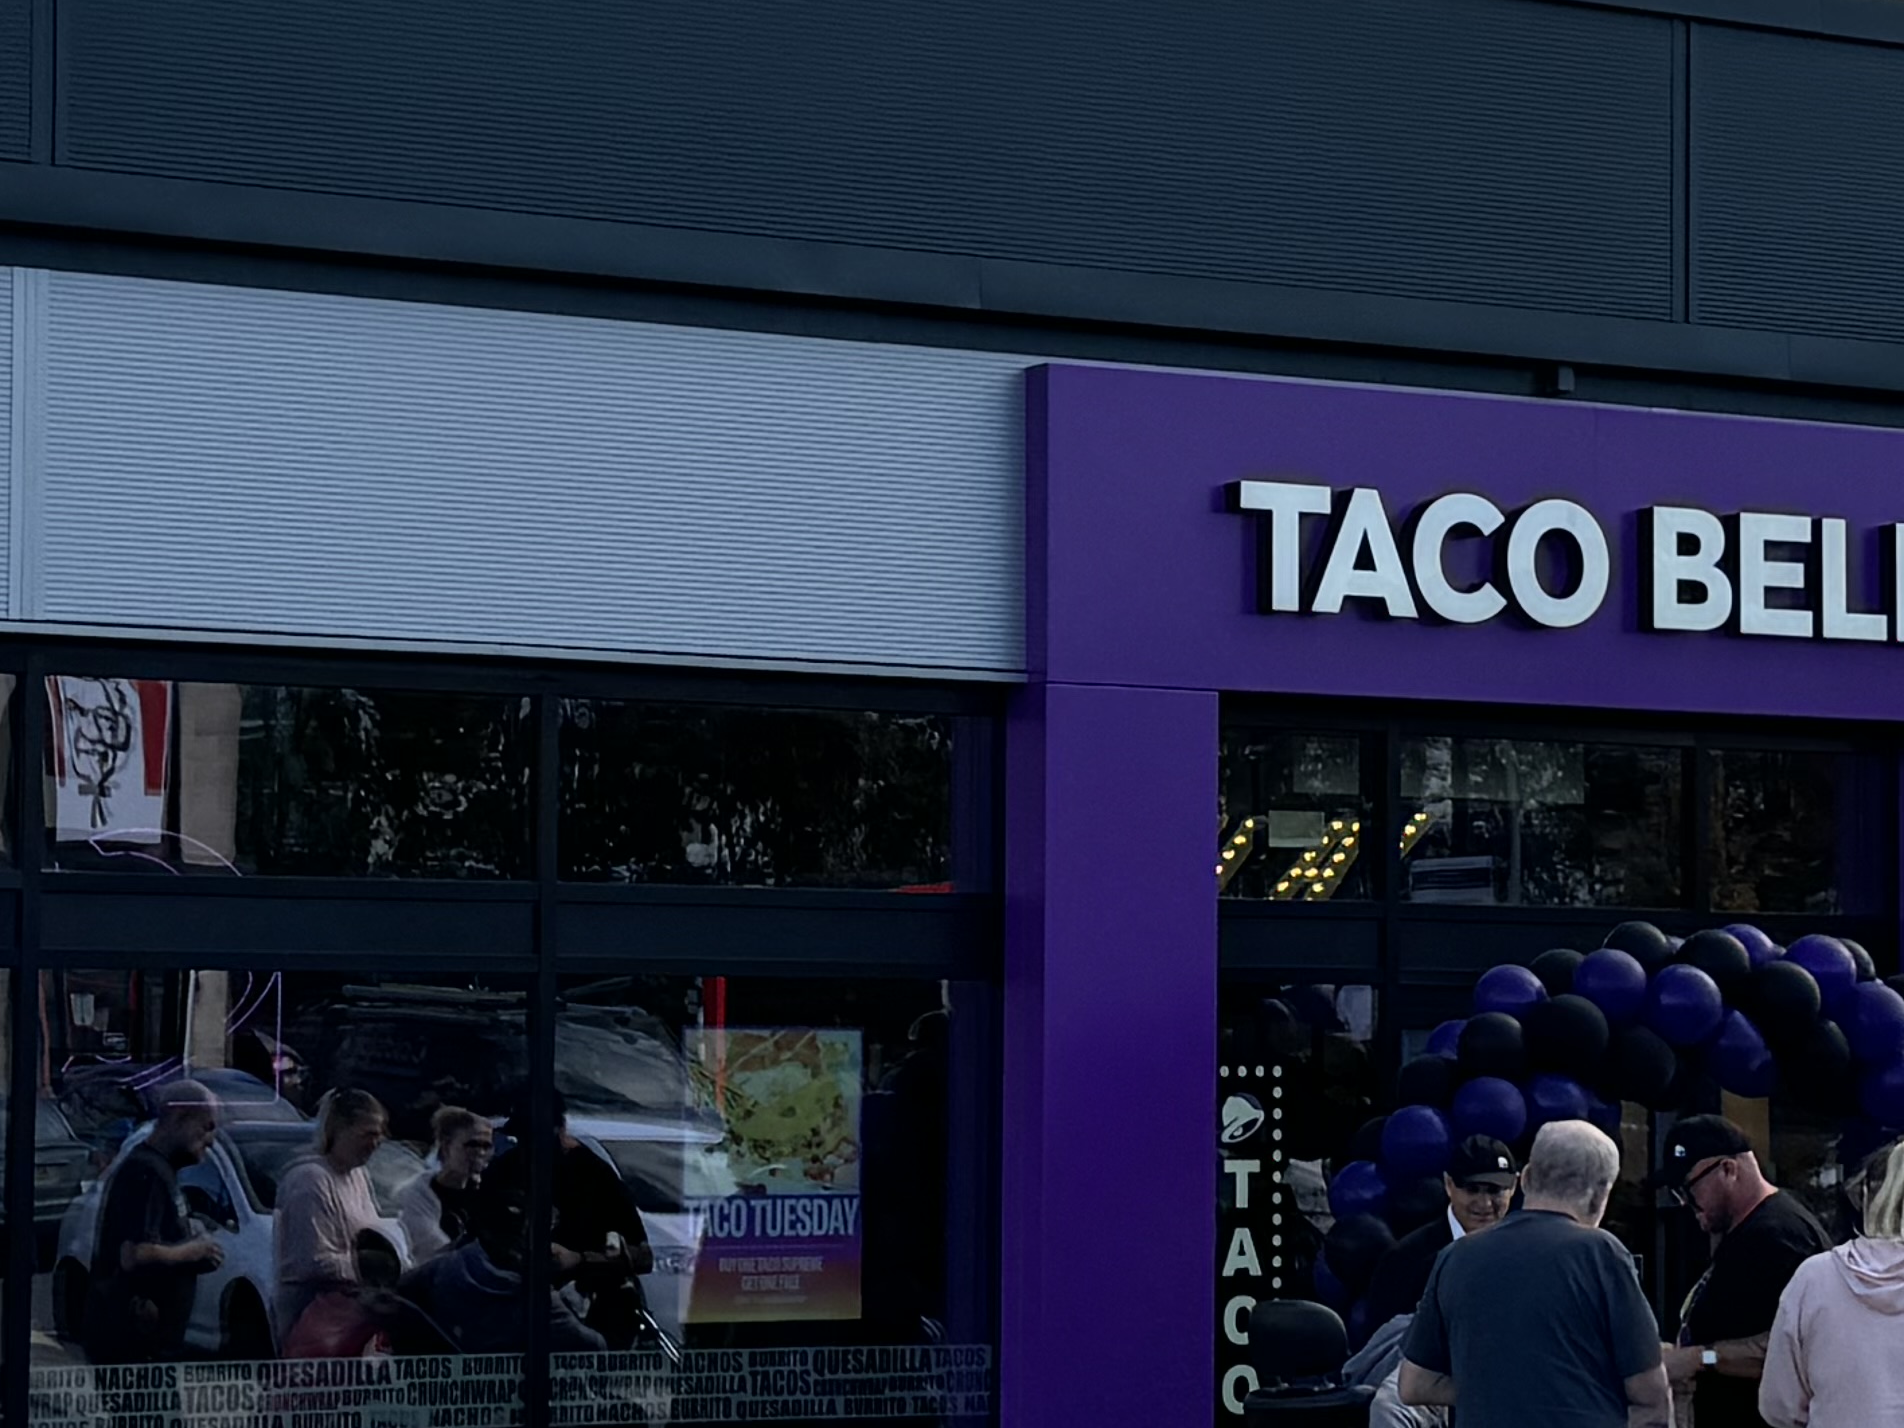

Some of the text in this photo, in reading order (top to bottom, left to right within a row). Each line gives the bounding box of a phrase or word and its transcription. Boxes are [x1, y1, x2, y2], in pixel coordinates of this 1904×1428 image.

[1239, 480, 1610, 629] TACO
[683, 1196, 860, 1239] TACO TUESDAY
[95, 1365, 177, 1391] NACHOS
[184, 1363, 252, 1383] BURRITO
[257, 1360, 392, 1390] QUESADILLA
[394, 1357, 452, 1380] TACOS
[553, 1354, 595, 1371] TACOS
[597, 1353, 663, 1372] BURRITO
[748, 1350, 809, 1368] BURRITO
[812, 1347, 932, 1377] QUESADILLA
[934, 1347, 986, 1368] TACOS
[76, 1391, 181, 1418] QUESADILLA
[183, 1383, 255, 1414] TACOS
[341, 1387, 405, 1406] BURRITO
[406, 1379, 517, 1406] CRUNCHWRAP
[749, 1369, 812, 1397] TACOS
[428, 1407, 506, 1428] NACHOS
[597, 1401, 667, 1422] NACHOS
[670, 1396, 732, 1420] BURRITO
[736, 1398, 837, 1420] QUESADILLA
[843, 1396, 907, 1415] BURRITO
[912, 1395, 958, 1414] TACOS
